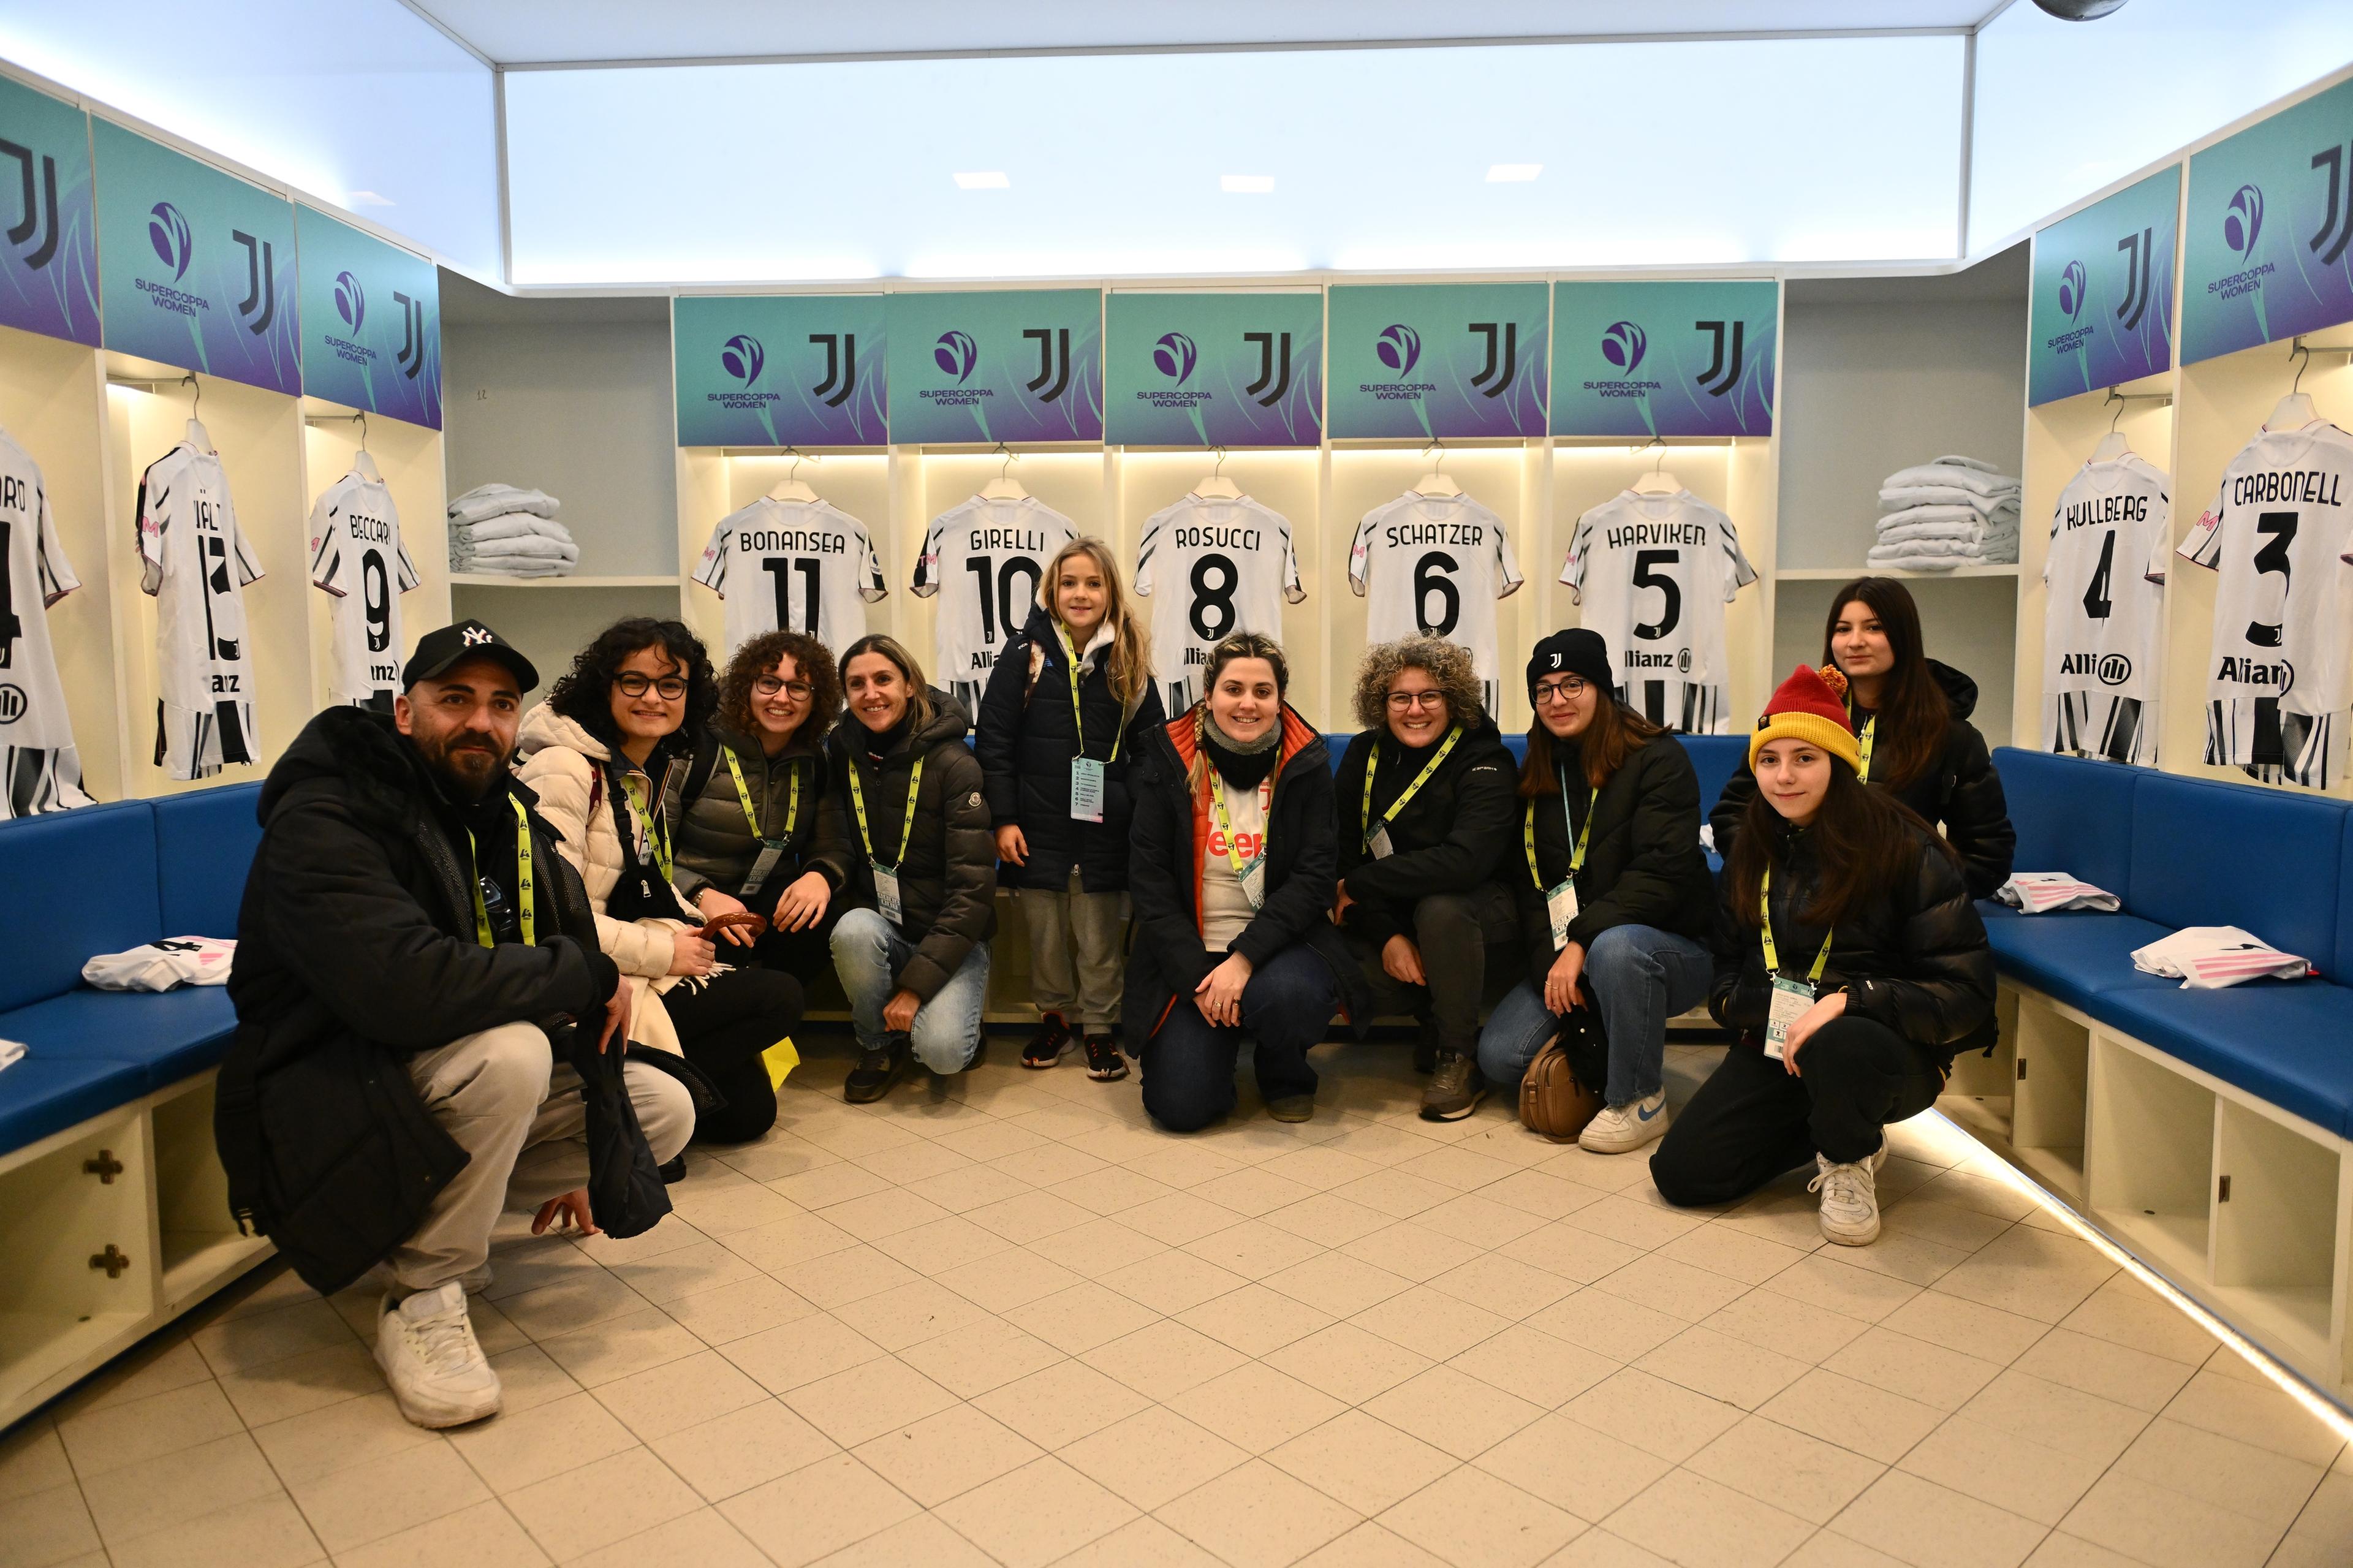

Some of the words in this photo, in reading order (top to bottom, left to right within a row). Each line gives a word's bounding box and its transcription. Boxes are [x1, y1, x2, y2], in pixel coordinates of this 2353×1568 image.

[2208, 262, 2275, 294] SUPERCOPPA
[2221, 279, 2260, 300] WOMEN
[135, 278, 210, 311] SUPERCOPPA
[151, 294, 197, 318] WOMEN
[325, 335, 377, 360] SUPERCOPPA
[2048, 325, 2094, 349] SUPERCOPPA
[2056, 338, 2084, 355] WOMEN
[336, 349, 368, 366] WOMEN
[919, 389, 994, 398] SUPERCOPPA
[1583, 381, 1661, 390] SUPERCOPPA
[707, 393, 781, 403] SUPERCOPPA
[723, 401, 767, 409] WOMEN
[935, 397, 980, 406] WOMEN
[1153, 399, 1197, 407] WOMEN
[2234, 471, 2342, 507] CARBONELL
[2067, 495, 2148, 531] KULLBERG
[350, 515, 391, 546] BECCARI
[971, 529, 1044, 551] GIRELLI
[1175, 527, 1261, 551] ROSUCCI
[1386, 524, 1483, 548] SCHATZER
[1607, 523, 1707, 550] HARVIKEN
[740, 532, 845, 555] BONANSEA
[362, 548, 391, 653] 9
[762, 558, 820, 638] 11
[966, 556, 1043, 644] 10
[1189, 553, 1238, 641] 8
[1414, 551, 1460, 637] 6
[1632, 550, 1681, 640] 5
